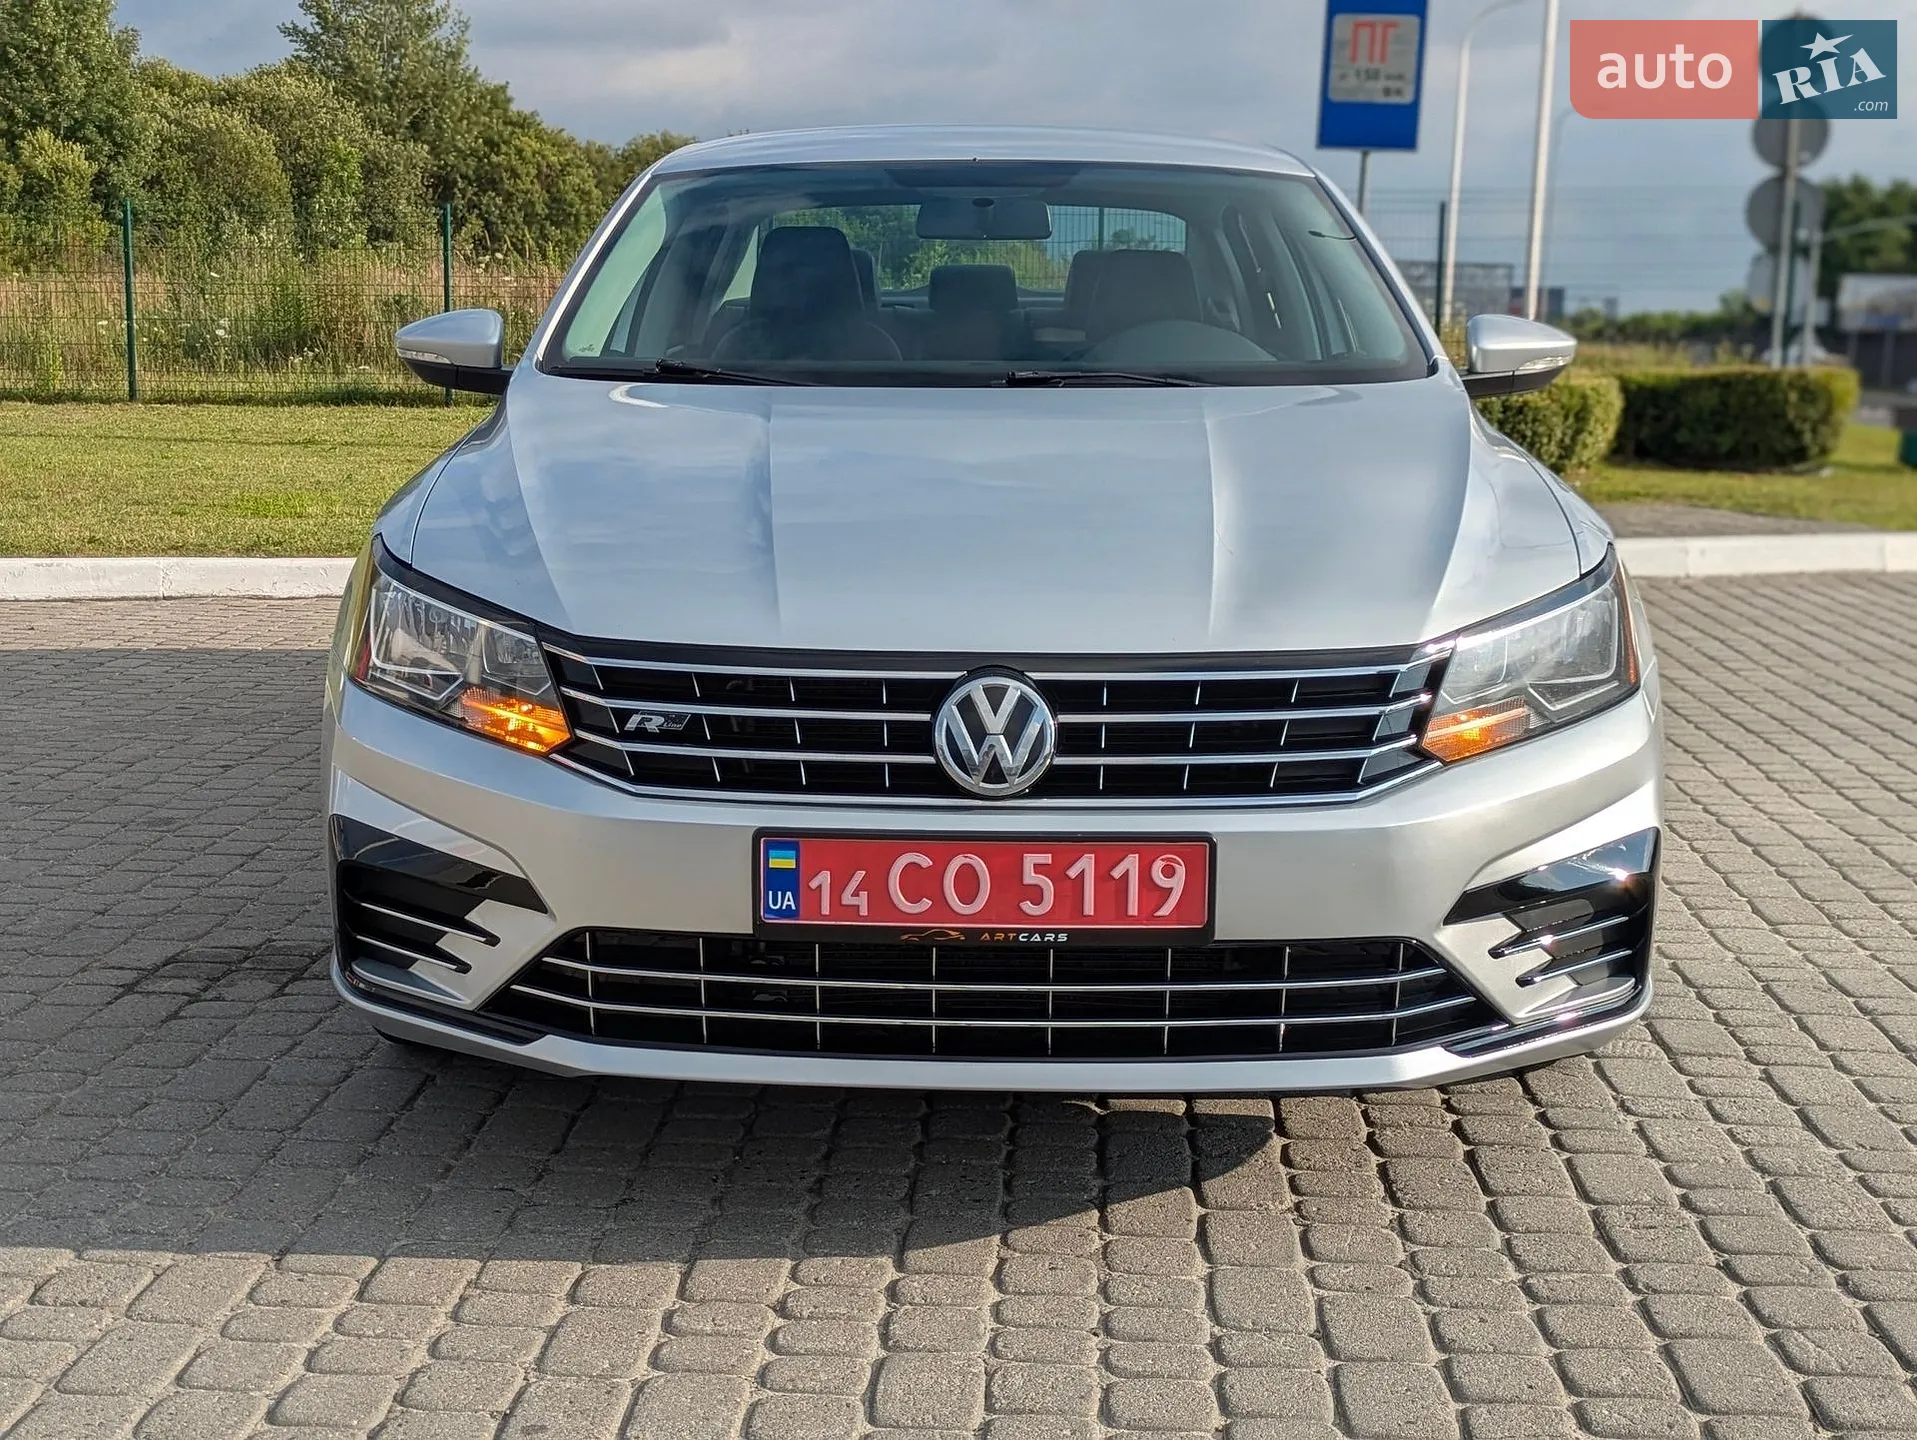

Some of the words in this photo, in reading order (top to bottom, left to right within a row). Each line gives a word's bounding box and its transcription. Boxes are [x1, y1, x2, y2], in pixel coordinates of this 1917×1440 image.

[808, 870, 869, 916] 14
[887, 852, 992, 916] CO
[1018, 853, 1187, 917] 5119
[768, 890, 796, 911] UA
[980, 932, 1069, 943] ARTCARS
